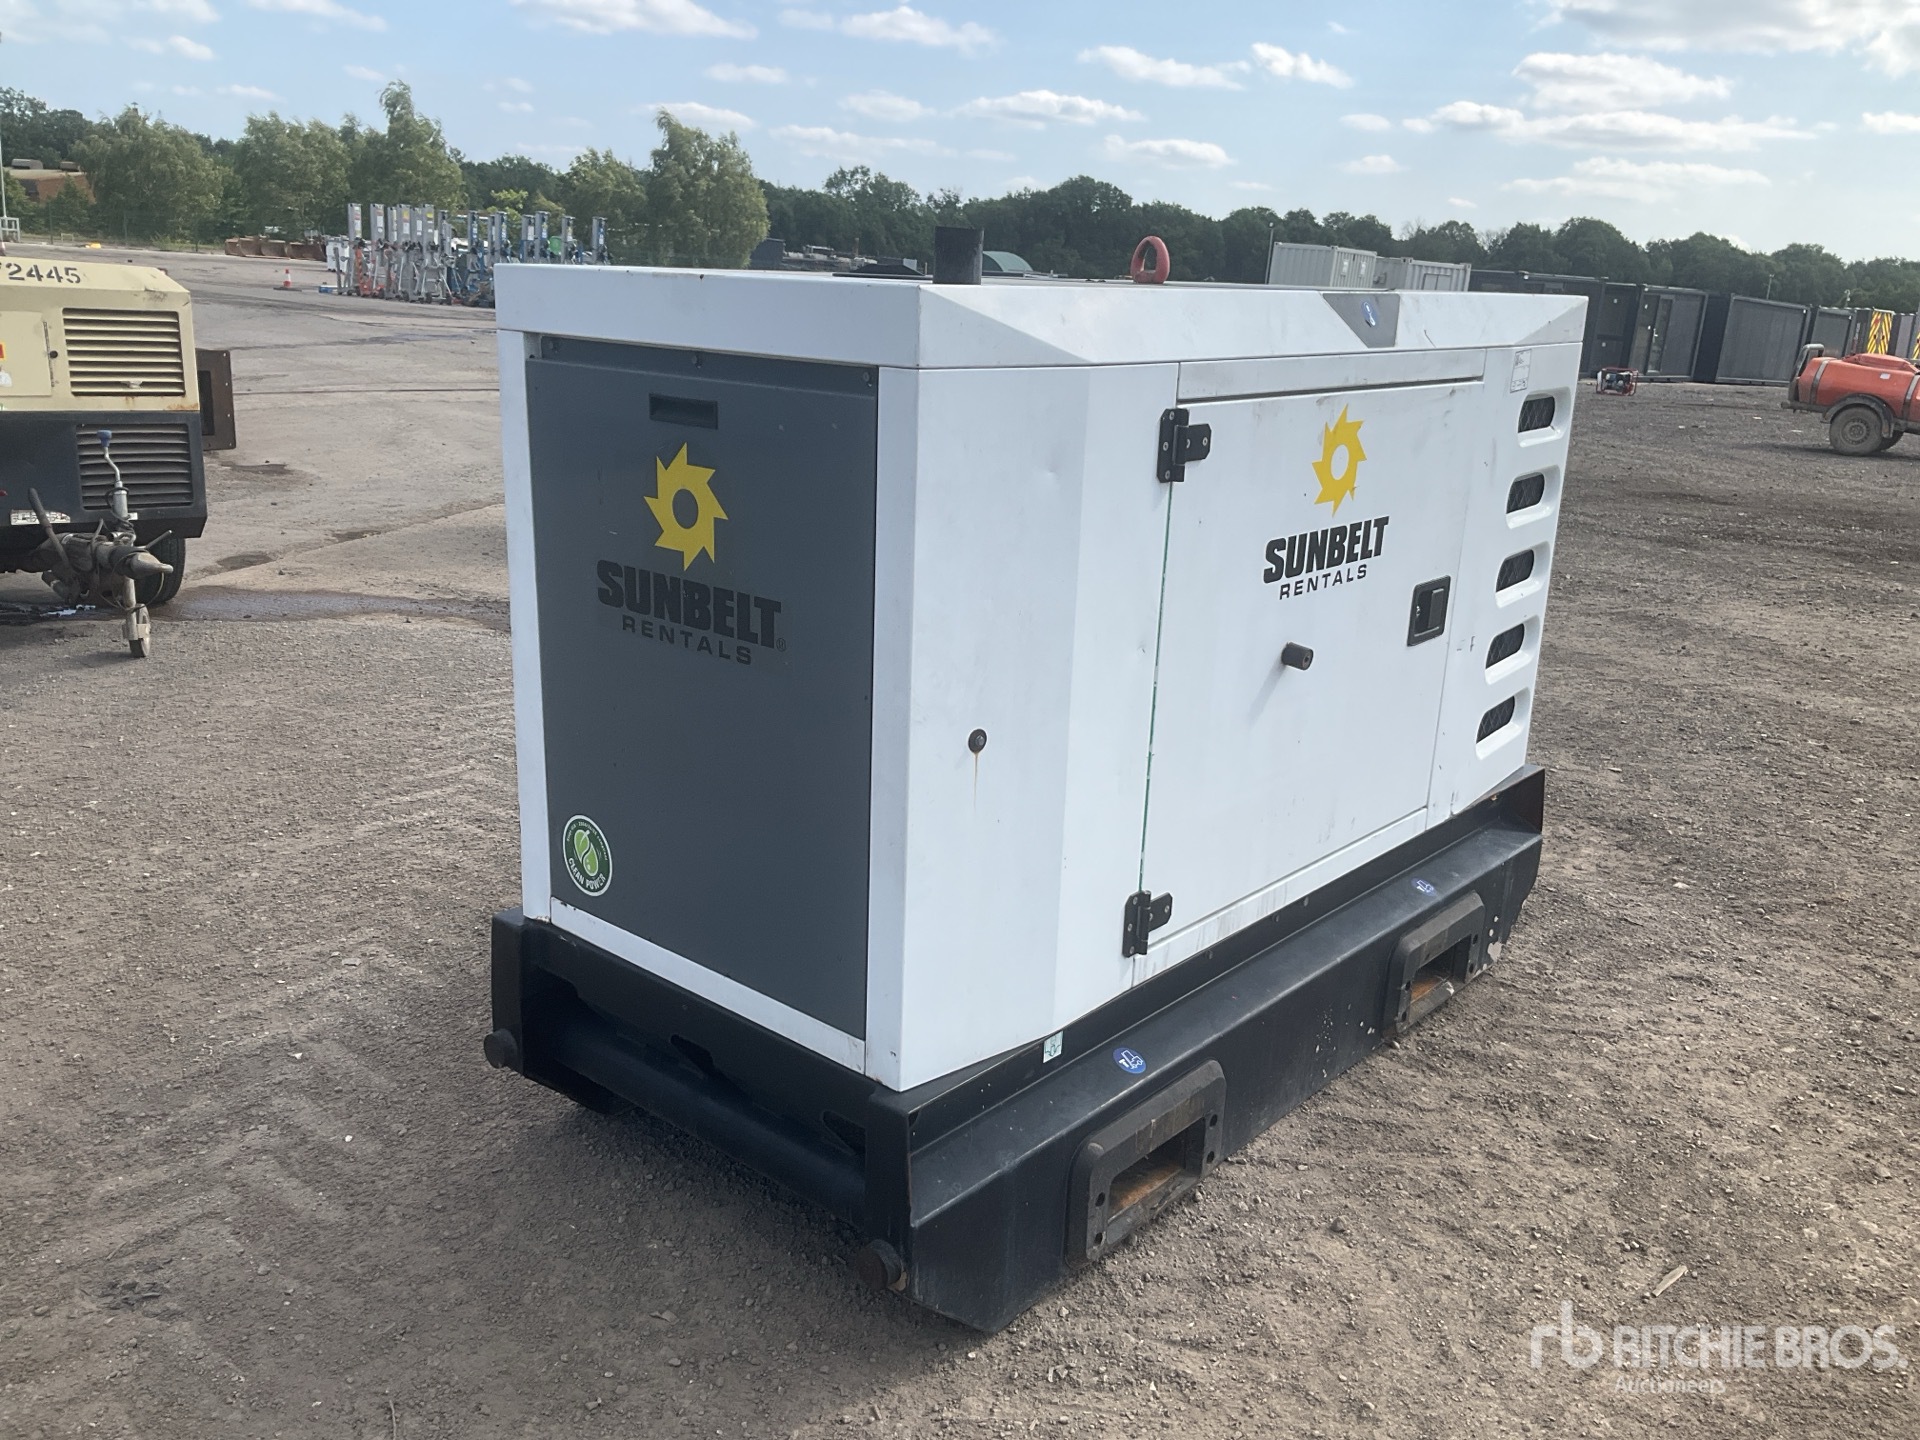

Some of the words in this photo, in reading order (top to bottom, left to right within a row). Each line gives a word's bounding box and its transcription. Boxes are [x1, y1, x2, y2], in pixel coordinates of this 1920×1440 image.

[0, 262, 81, 284] 2445
[1263, 515, 1390, 584] SUNBELT
[1279, 564, 1367, 600] RENTALS
[596, 559, 782, 649] SUNBELT
[622, 614, 752, 665] RENTALS
[568, 857, 585, 885] CLEAN
[585, 873, 606, 890] POWER
